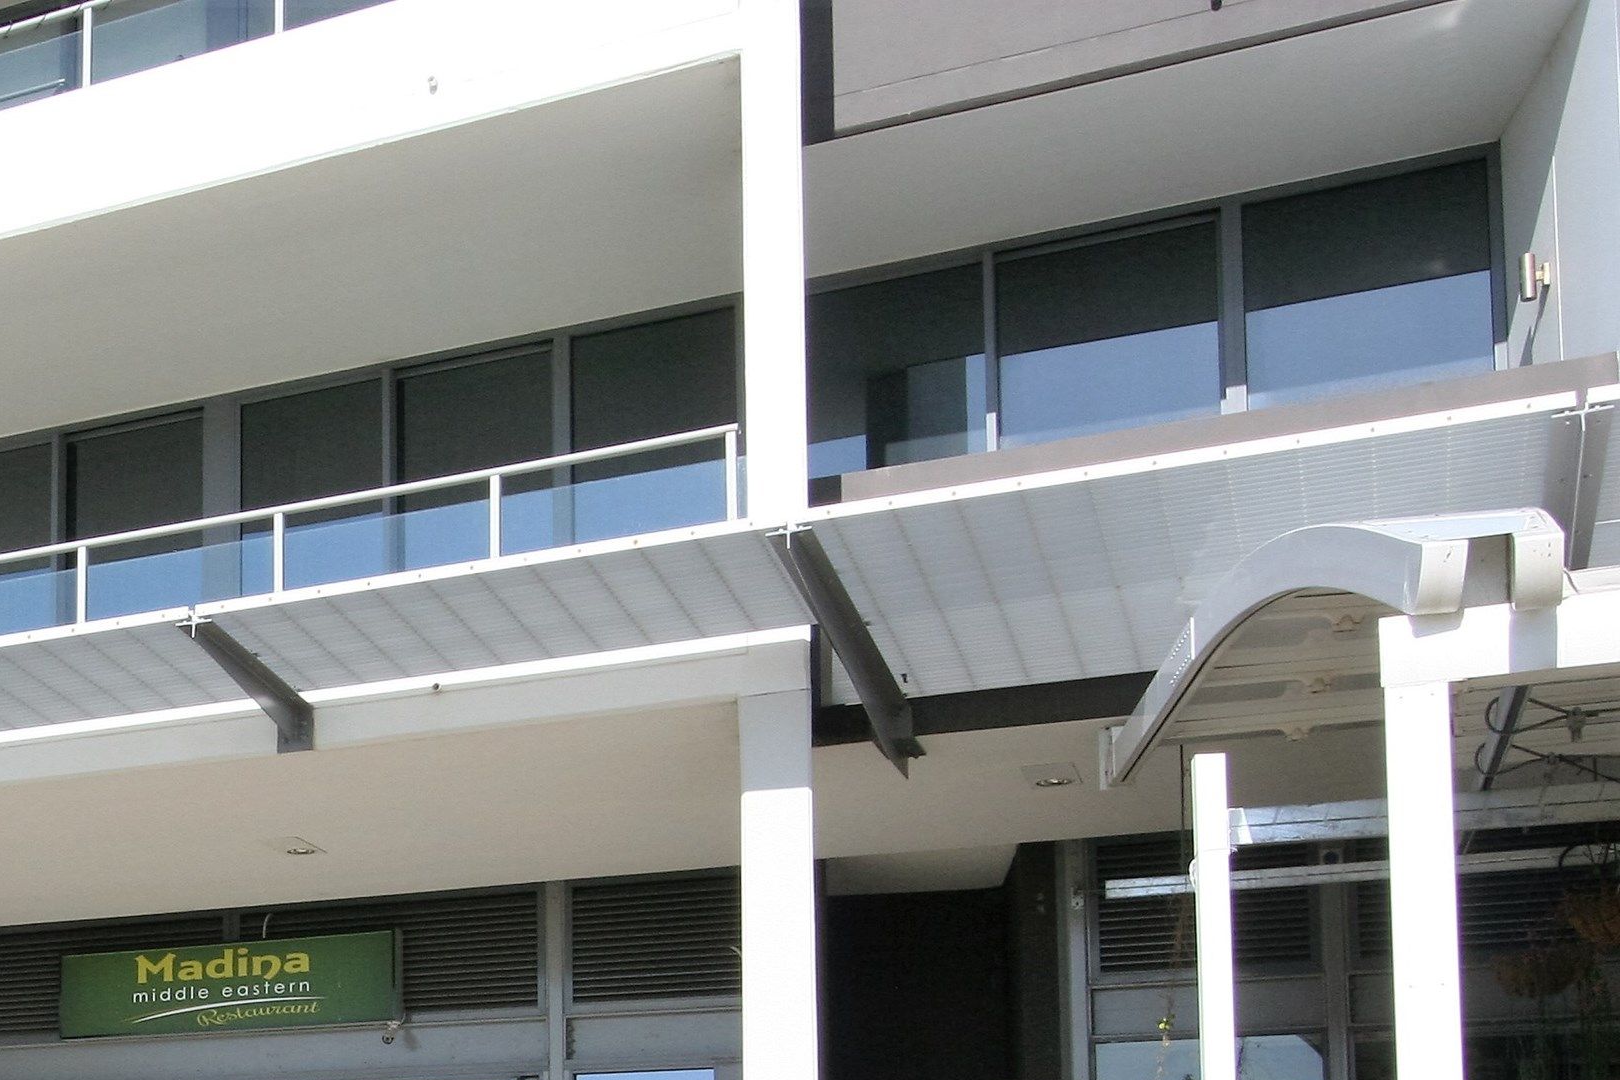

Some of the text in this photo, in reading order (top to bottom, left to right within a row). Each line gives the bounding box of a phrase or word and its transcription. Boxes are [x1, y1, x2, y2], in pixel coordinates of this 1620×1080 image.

[134, 947, 311, 984] Madina
[133, 981, 310, 1003] middle eastern
[196, 1001, 321, 1026] Restaurant
